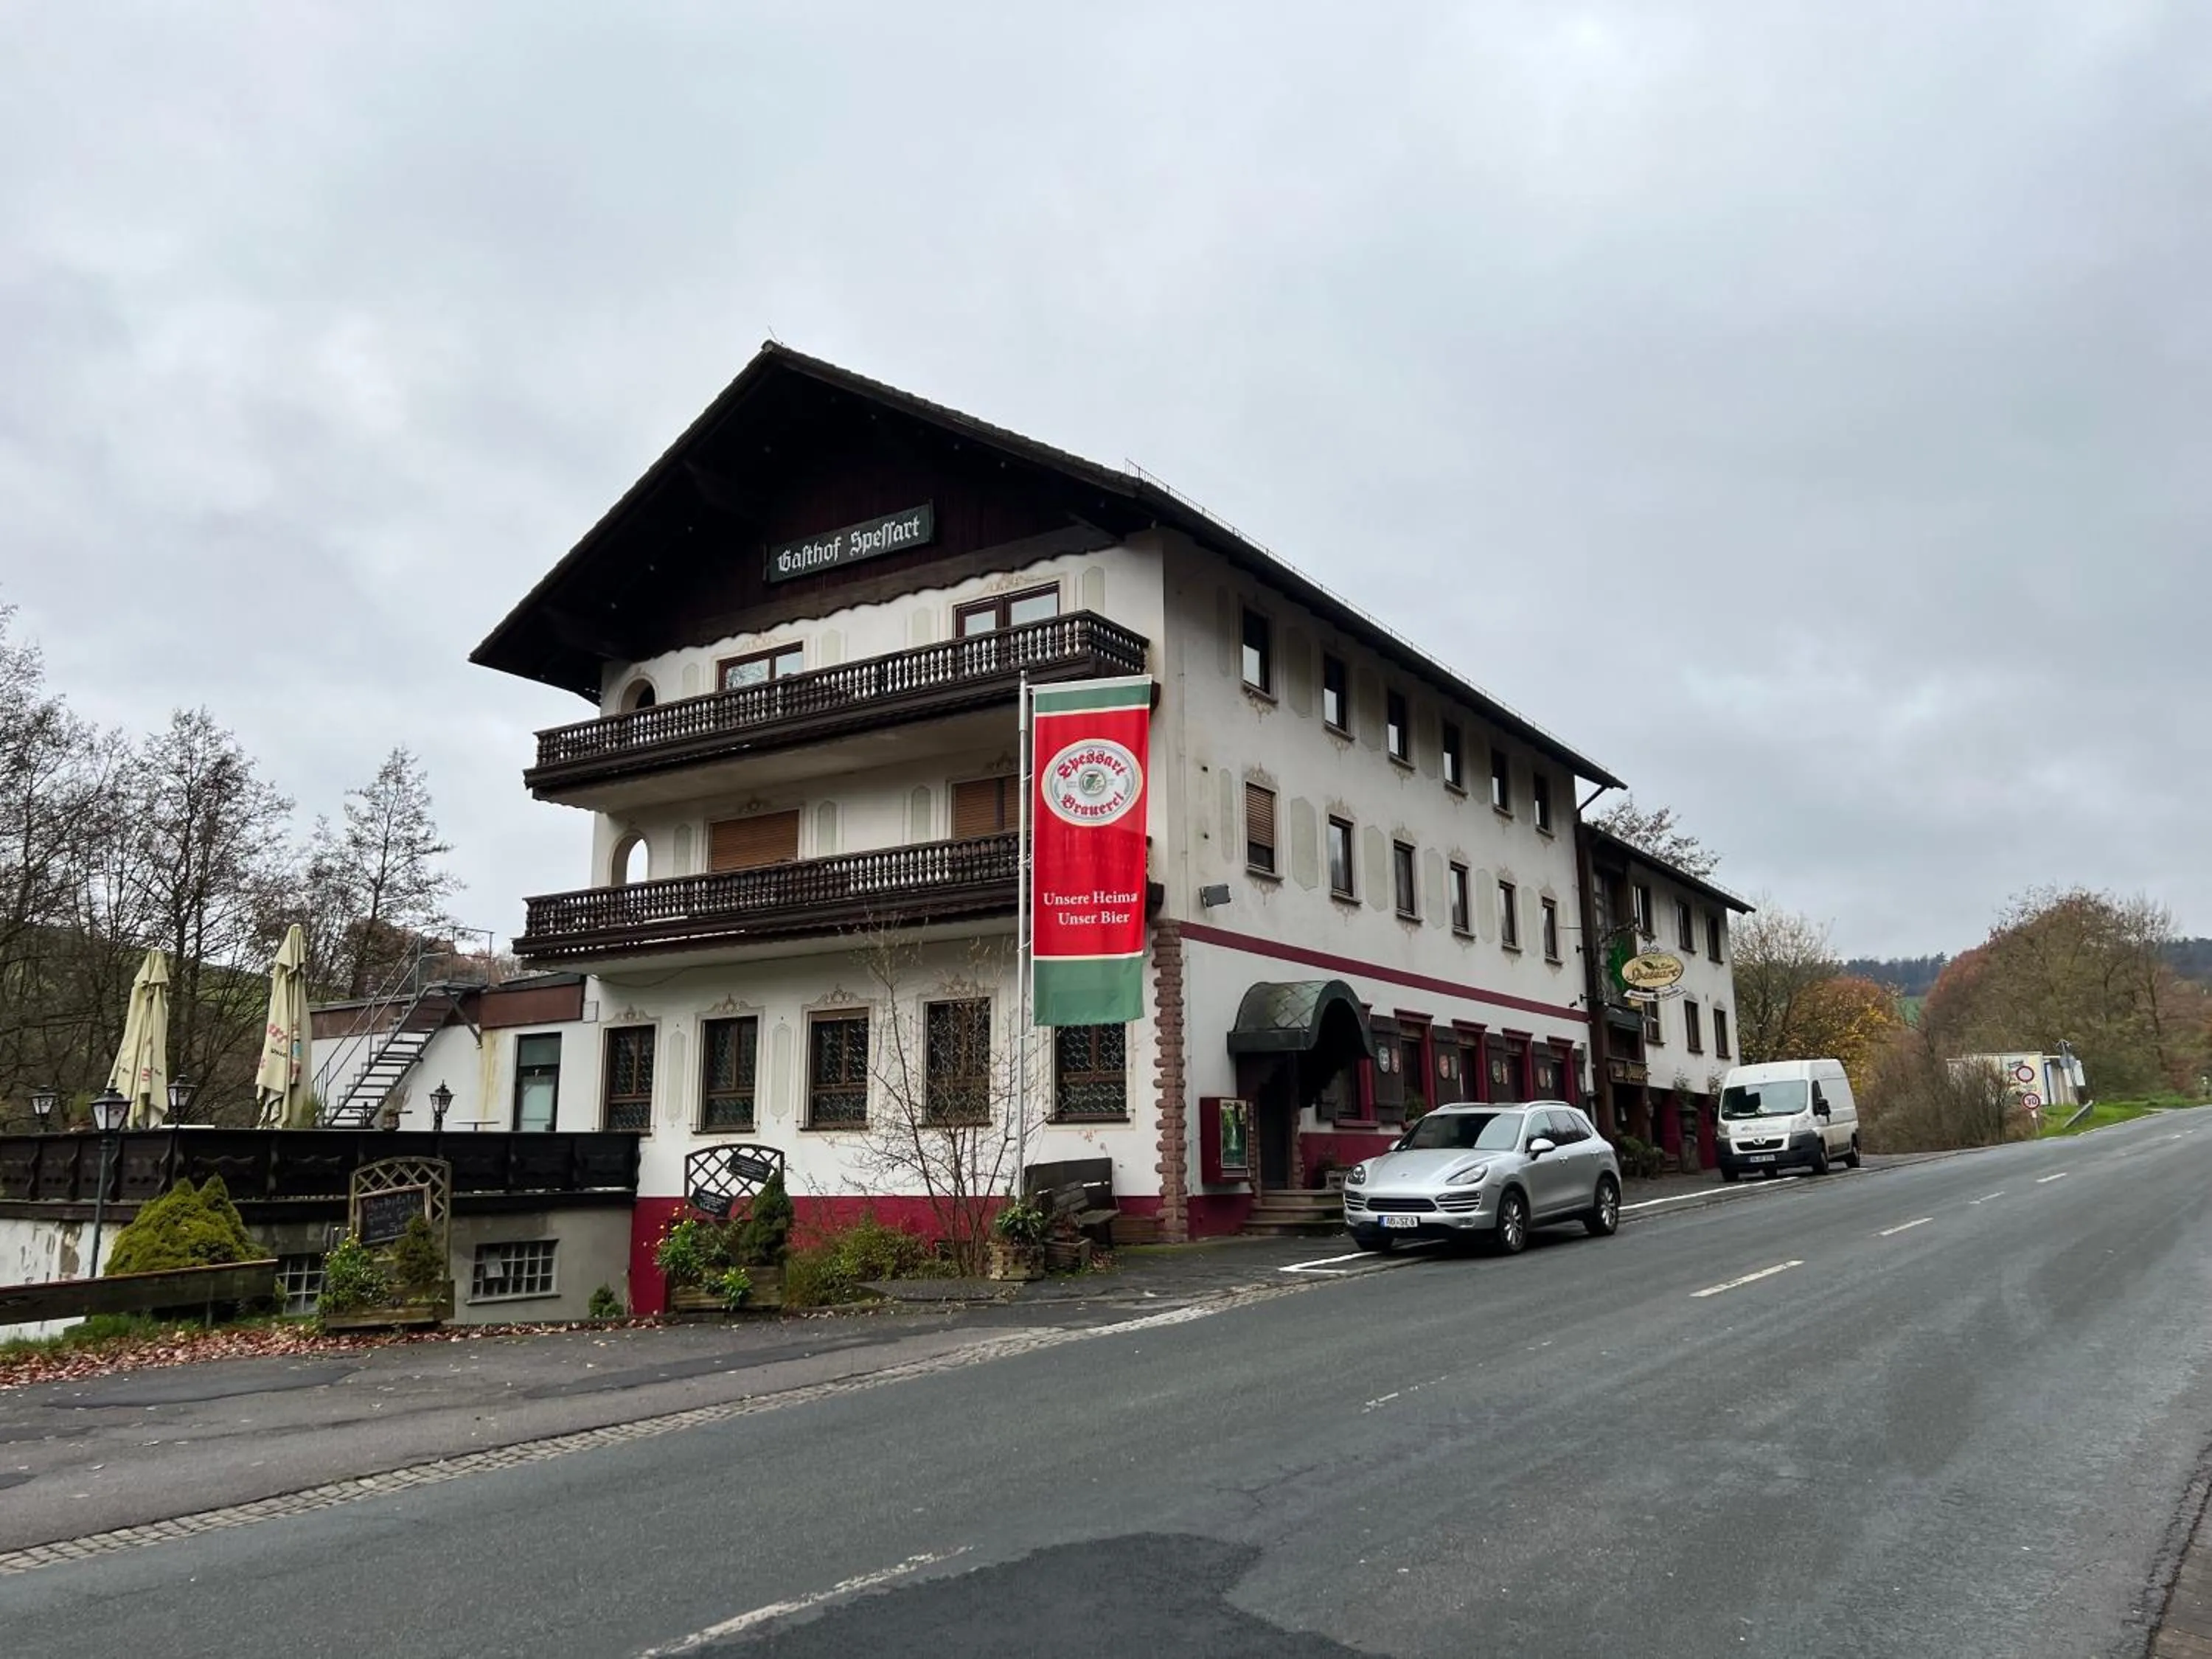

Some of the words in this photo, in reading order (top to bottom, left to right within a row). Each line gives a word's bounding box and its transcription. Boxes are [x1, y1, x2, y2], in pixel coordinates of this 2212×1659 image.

[1057, 749, 1127, 779] Spessart
[1061, 792, 1124, 816] Brauerei
[1043, 892, 1090, 905] Unsere
[1093, 890, 1138, 904] Heima
[1057, 912, 1097, 925] Unser
[1101, 911, 1130, 924] Bier
